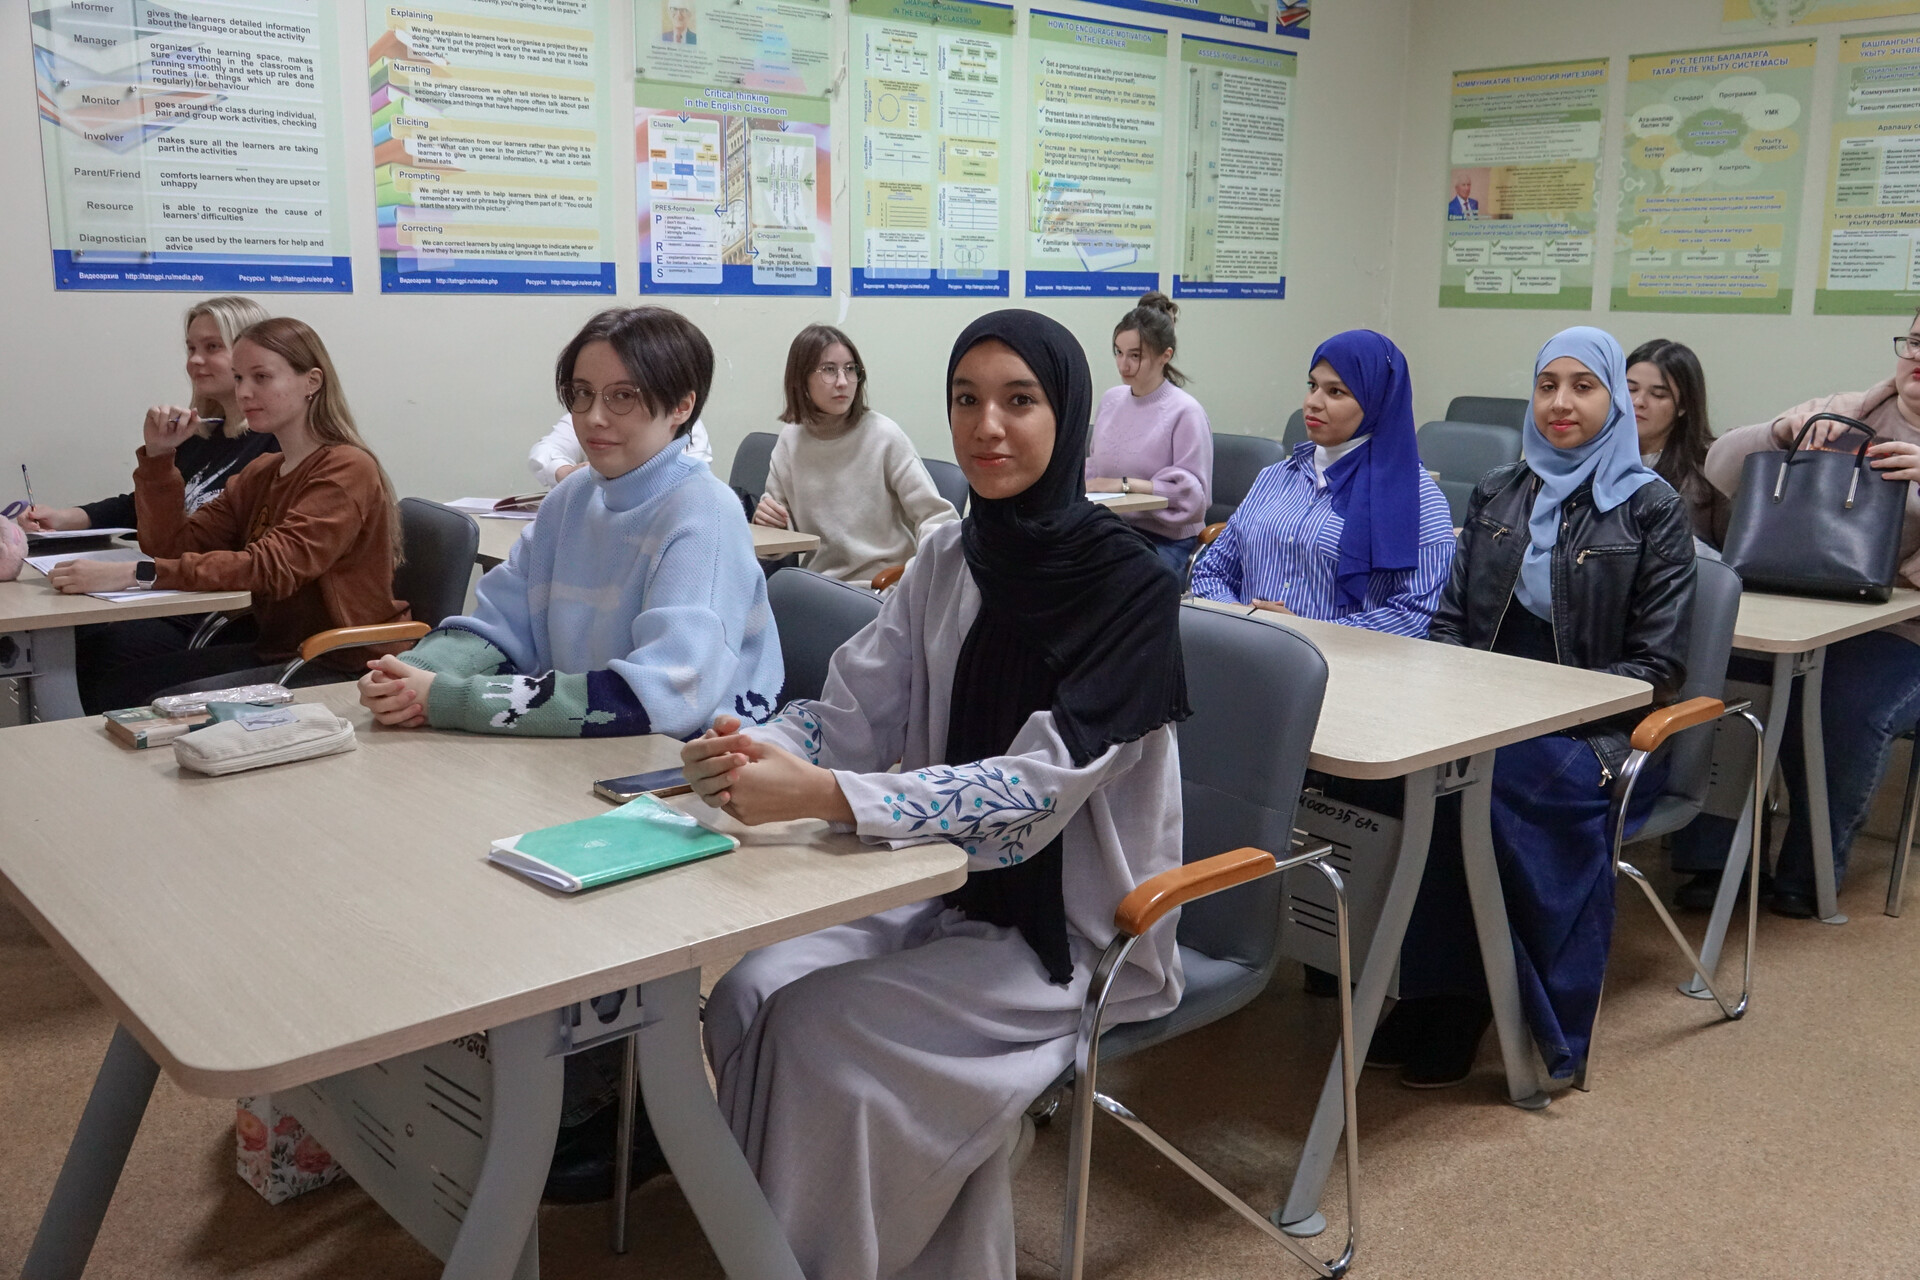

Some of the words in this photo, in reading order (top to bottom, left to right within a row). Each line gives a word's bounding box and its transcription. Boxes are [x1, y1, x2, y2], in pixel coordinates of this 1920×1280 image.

[71, 1, 114, 12] Informer
[390, 8, 433, 21] Explaining
[943, 13, 981, 26] CLASSROOM
[147, 10, 170, 20] gives
[191, 15, 225, 25] learners
[229, 18, 262, 28] detailed
[265, 22, 310, 33] information
[1220, 15, 1235, 25] Albert
[1236, 18, 1256, 28] Einstein
[1049, 21, 1063, 29] HOW
[1076, 24, 1114, 36] ENCOURAGE
[1116, 30, 1152, 42] MOTIVATION
[74, 34, 117, 47] Manager
[1098, 38, 1126, 48] LEARNER
[1862, 39, 1914, 48] БАШЛАНГЫЧ
[150, 42, 192, 54] organizes
[217, 48, 250, 60] learning
[256, 54, 282, 62] space,
[287, 55, 312, 64] makes
[1717, 51, 1769, 61] БАЛАЛАРГА
[1199, 50, 1220, 58] ASSESS
[1266, 59, 1281, 67] LEVEL
[394, 63, 430, 75] Narrating
[1652, 68, 1676, 76] ТАТАР
[1679, 66, 1698, 74] ТЕЛЕ
[1702, 63, 1729, 72] УКЫТУ
[1732, 58, 1788, 69] СИСТЕМАСЫ
[1456, 78, 1510, 88] КОММУНИКАТИВ
[1513, 73, 1559, 83] ТЕХНОЛОГИЯ
[1562, 70, 1604, 79] НИГЕЗЛӘРЕ
[704, 88, 734, 99] Critical
[736, 91, 769, 104] thinking
[1719, 90, 1757, 99] Программа
[82, 95, 120, 105] Monitor
[155, 102, 175, 110] goes
[177, 103, 208, 111] around
[224, 106, 246, 114] class
[248, 108, 274, 118] during
[276, 110, 316, 121] individual,
[685, 98, 693, 107] in
[696, 99, 708, 108] the
[711, 101, 742, 112] English
[744, 103, 787, 115] Classroom
[396, 117, 429, 128] Eliciting
[84, 132, 124, 142] Involver
[158, 137, 185, 145] makes
[242, 142, 274, 150] learners
[294, 145, 318, 154] taking
[74, 168, 141, 178] Parent/Friend
[399, 171, 440, 181] Prompting
[160, 172, 197, 180] comforts
[199, 174, 232, 182] learners
[257, 177, 274, 185] they
[289, 178, 310, 187] upset
[161, 180, 197, 189] unhappy
[87, 201, 134, 211] Resource
[218, 206, 258, 215] recognize
[200, 213, 243, 221] difficulties
[656, 215, 662, 224] P
[402, 224, 443, 234] Correcting
[79, 234, 147, 244] Diagnostician
[216, 237, 226, 245] by
[291, 239, 307, 247] help
[656, 242, 663, 251] R
[657, 256, 663, 265] E
[657, 268, 664, 277] S
[239, 274, 265, 282] Ресурсы
